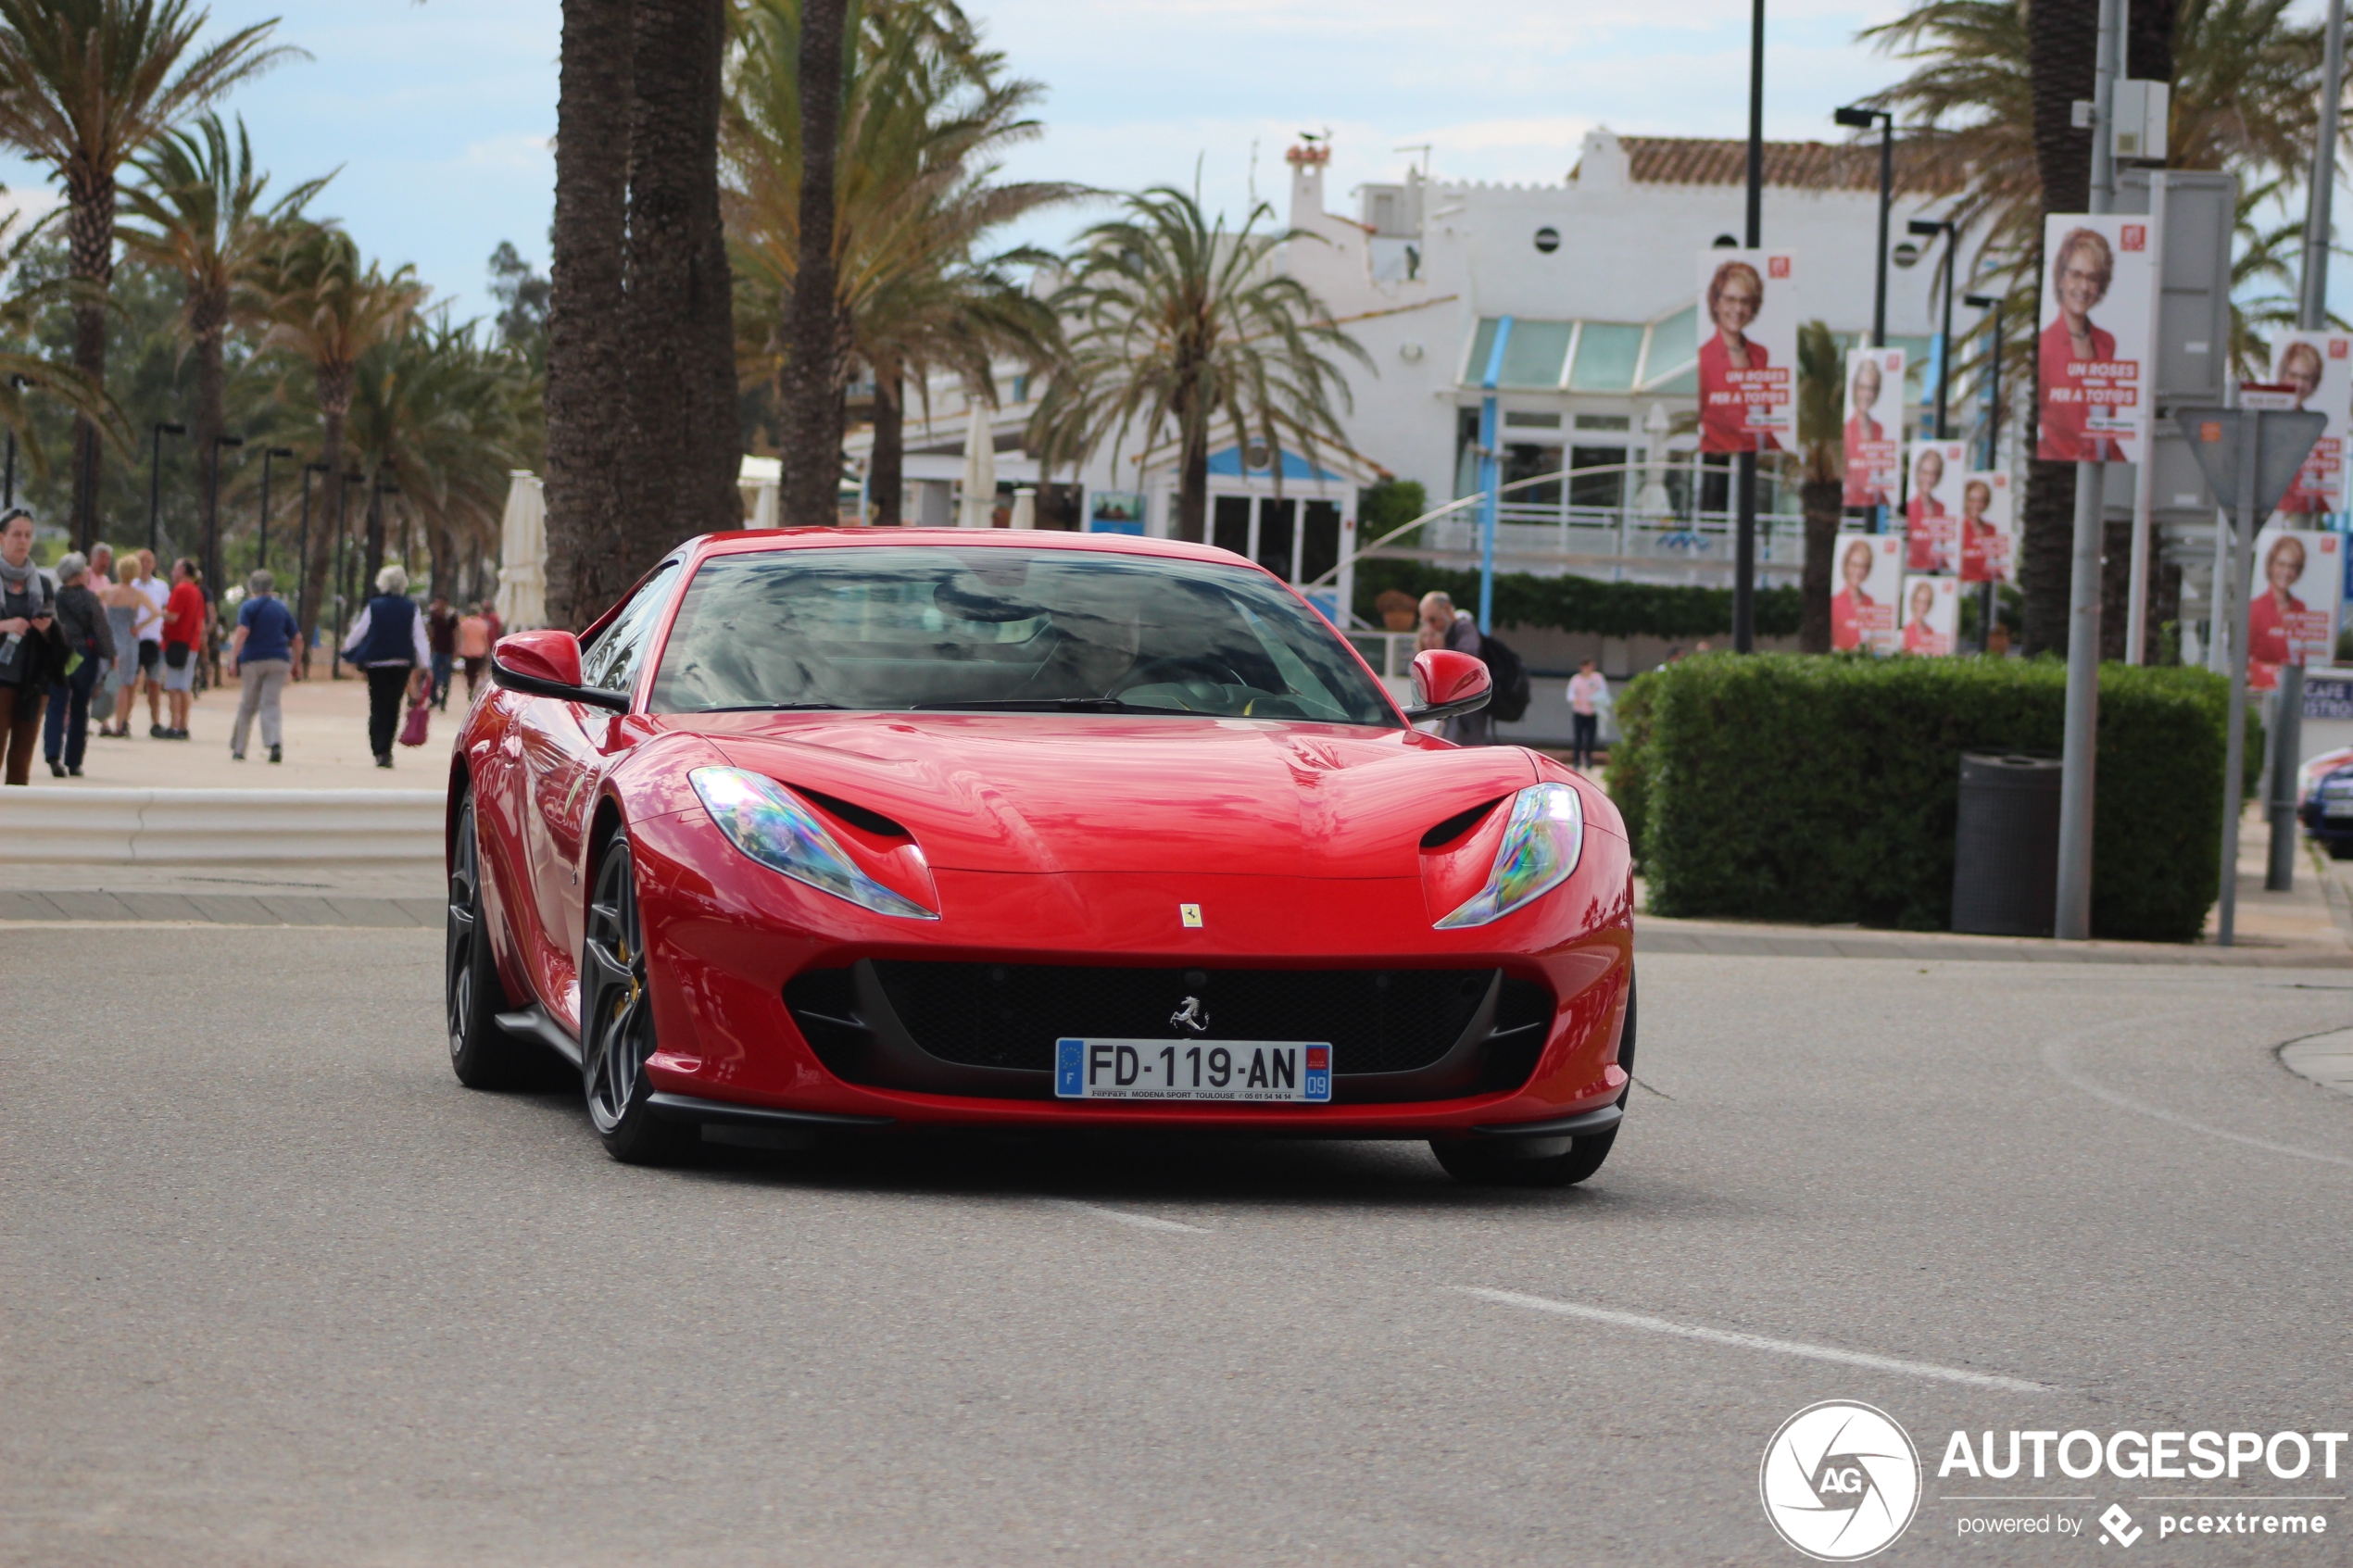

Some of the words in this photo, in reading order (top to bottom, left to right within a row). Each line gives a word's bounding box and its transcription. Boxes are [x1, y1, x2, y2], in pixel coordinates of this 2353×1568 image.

[1726, 370, 1743, 383] UN
[1746, 370, 1786, 382] ROSES
[2068, 362, 2086, 377] UN
[2089, 362, 2134, 378] ROSES
[1709, 392, 1730, 405] PER
[1732, 392, 1742, 405] A
[2049, 387, 2071, 402] PER
[2072, 387, 2082, 402] A
[2304, 683, 2345, 699] CAFE
[2304, 699, 2352, 717] ISTRO
[1089, 1045, 1295, 1088] FD-119-AN
[1066, 1073, 1075, 1085] F
[1307, 1076, 1326, 1094] 09
